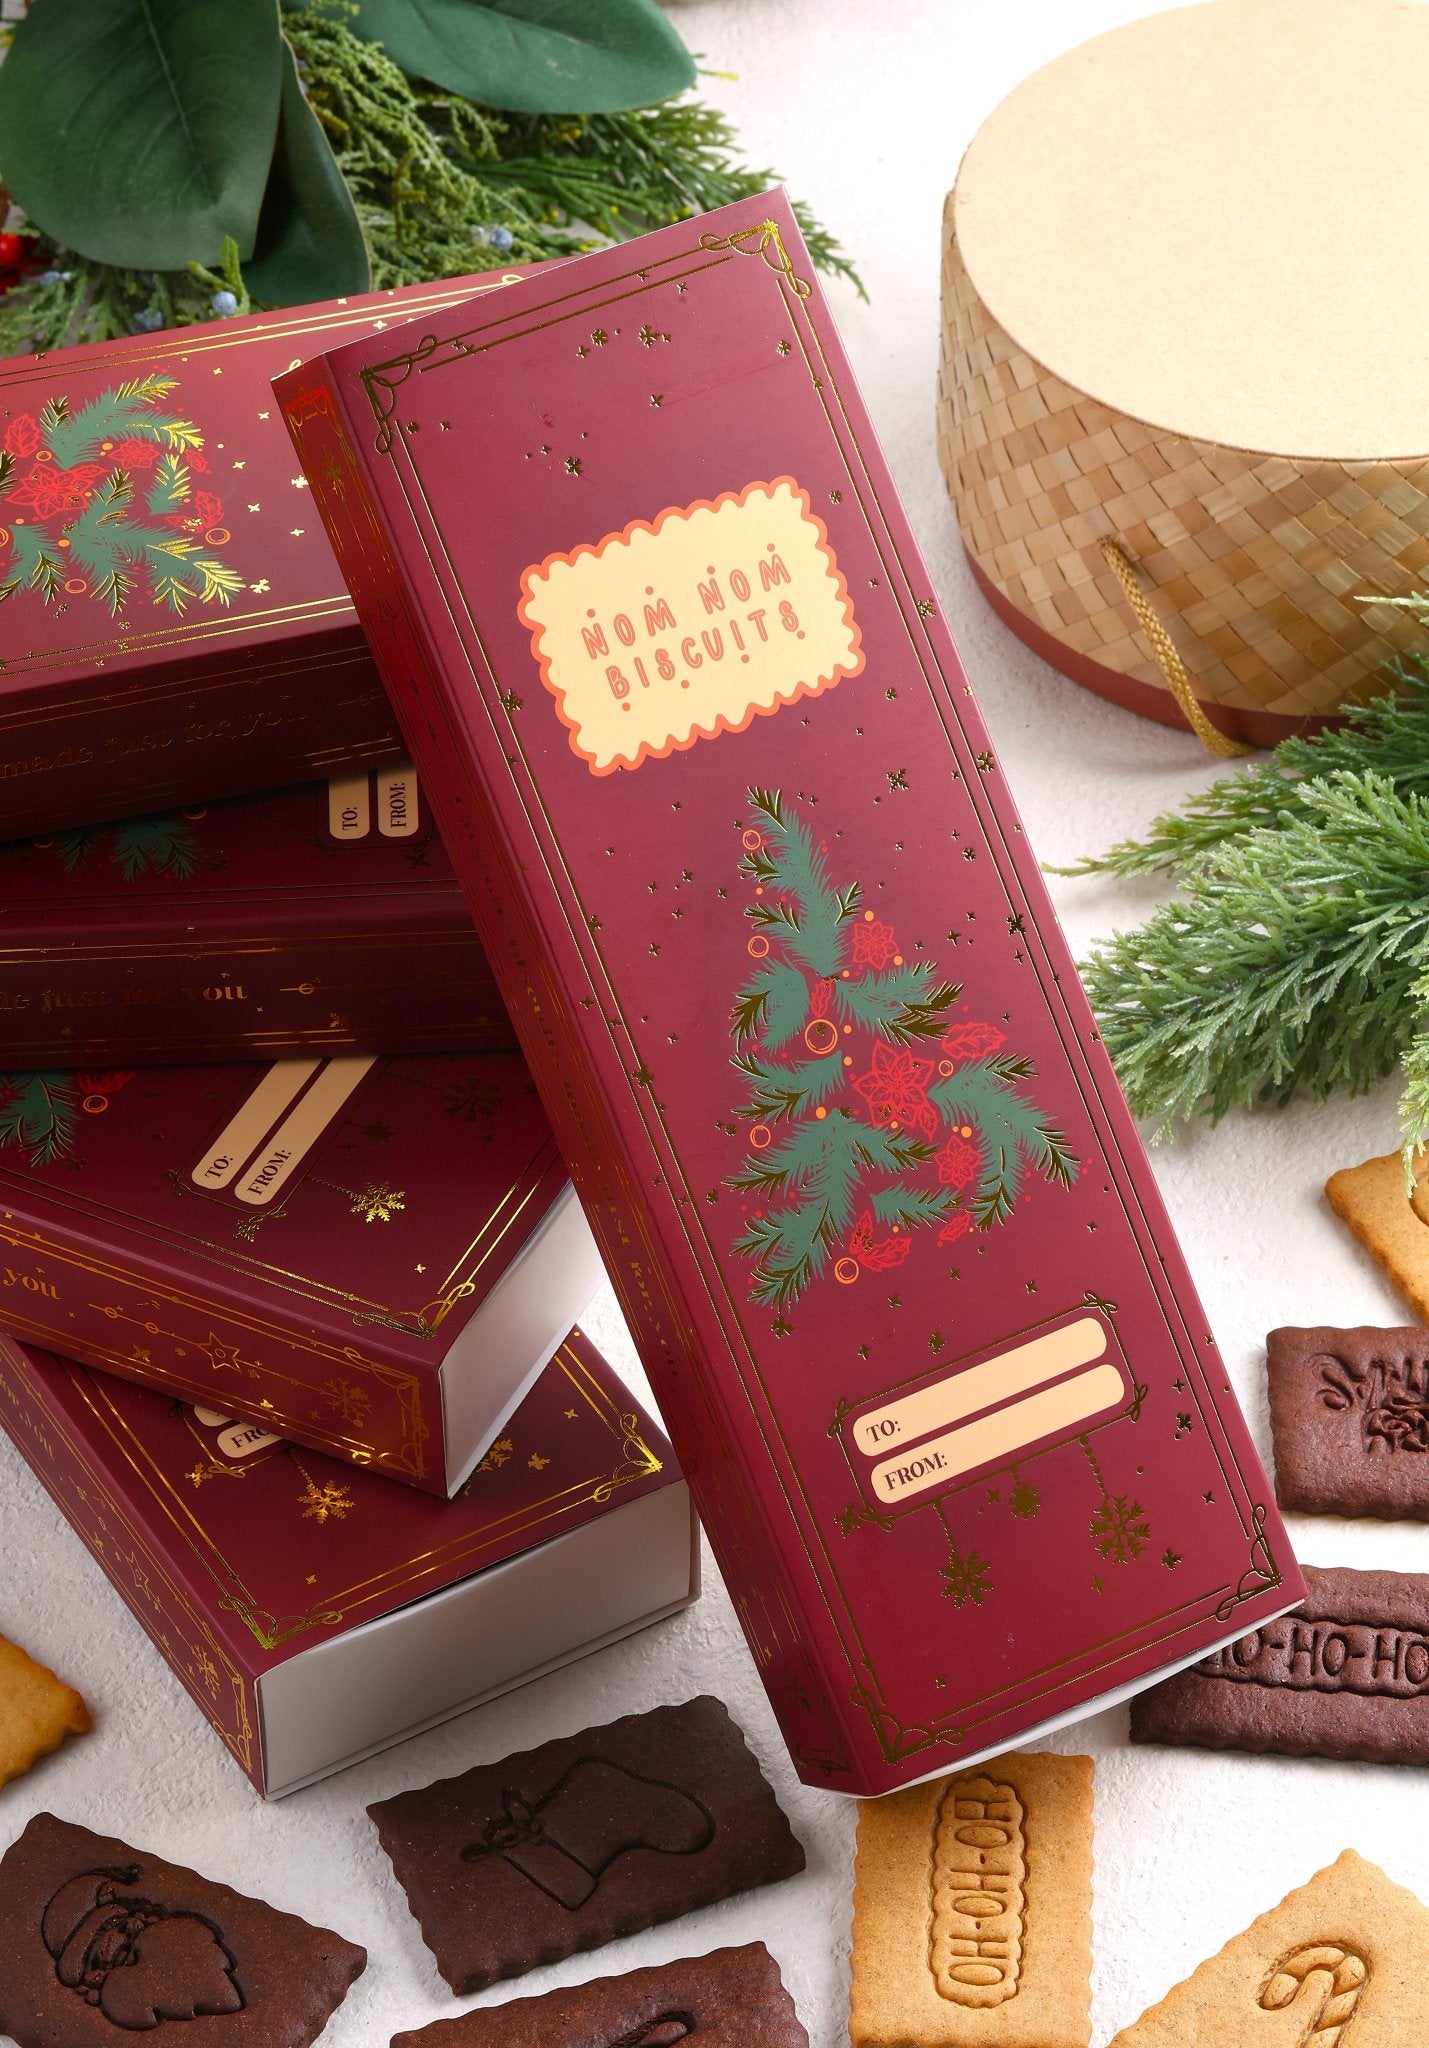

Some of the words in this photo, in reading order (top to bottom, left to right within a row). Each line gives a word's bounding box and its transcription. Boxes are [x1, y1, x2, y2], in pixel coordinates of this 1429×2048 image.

[581, 588, 677, 660] NOM
[697, 546, 792, 615] NOM
[605, 600, 803, 704] BISCUITS
[104, 729, 175, 763] just
[341, 806, 358, 831] TO:
[389, 782, 407, 829] FROM:
[181, 984, 248, 1008] you
[204, 1155, 234, 1179] TO:
[246, 1149, 293, 1196] FROM:
[3, 1267, 62, 1300] you
[865, 1418, 902, 1444] TO:
[882, 1452, 948, 1492] FROM:
[949, 1798, 1014, 1987] HO-HO-HO
